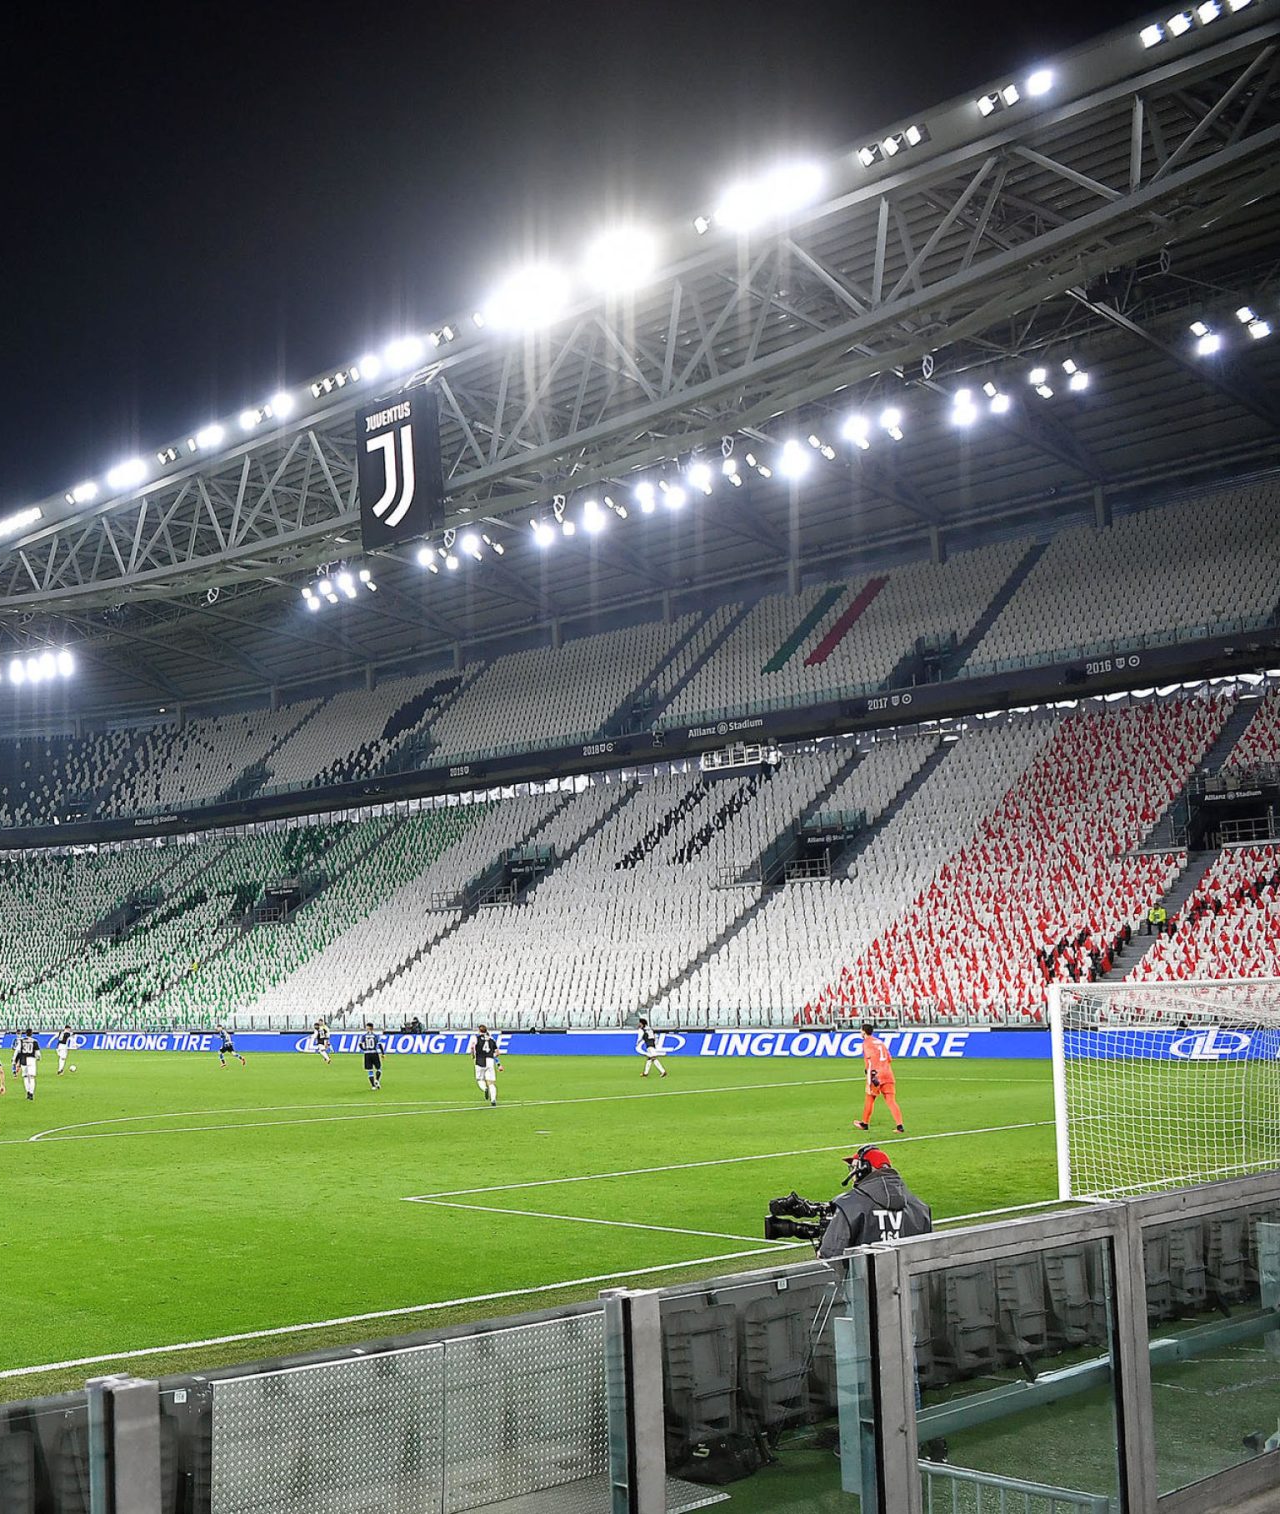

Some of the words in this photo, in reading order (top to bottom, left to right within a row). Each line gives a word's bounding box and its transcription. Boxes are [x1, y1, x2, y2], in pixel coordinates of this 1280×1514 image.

[365, 401, 411, 432] JUVENTUS
[1086, 660, 1111, 675] 2016
[868, 697, 888, 711] 2017
[688, 726, 716, 739] Allianz
[728, 718, 763, 731] Stadium
[583, 745, 600, 756] 2018
[134, 818, 152, 826] Allianz
[22, 1043, 34, 1054] 30
[92, 1033, 170, 1051] LINGLONG
[173, 1033, 213, 1051] TIRE
[482, 1042, 490, 1053] 4
[700, 1033, 864, 1057] LINGLONG
[878, 1045, 887, 1062] 1
[873, 1210, 903, 1230] TV
